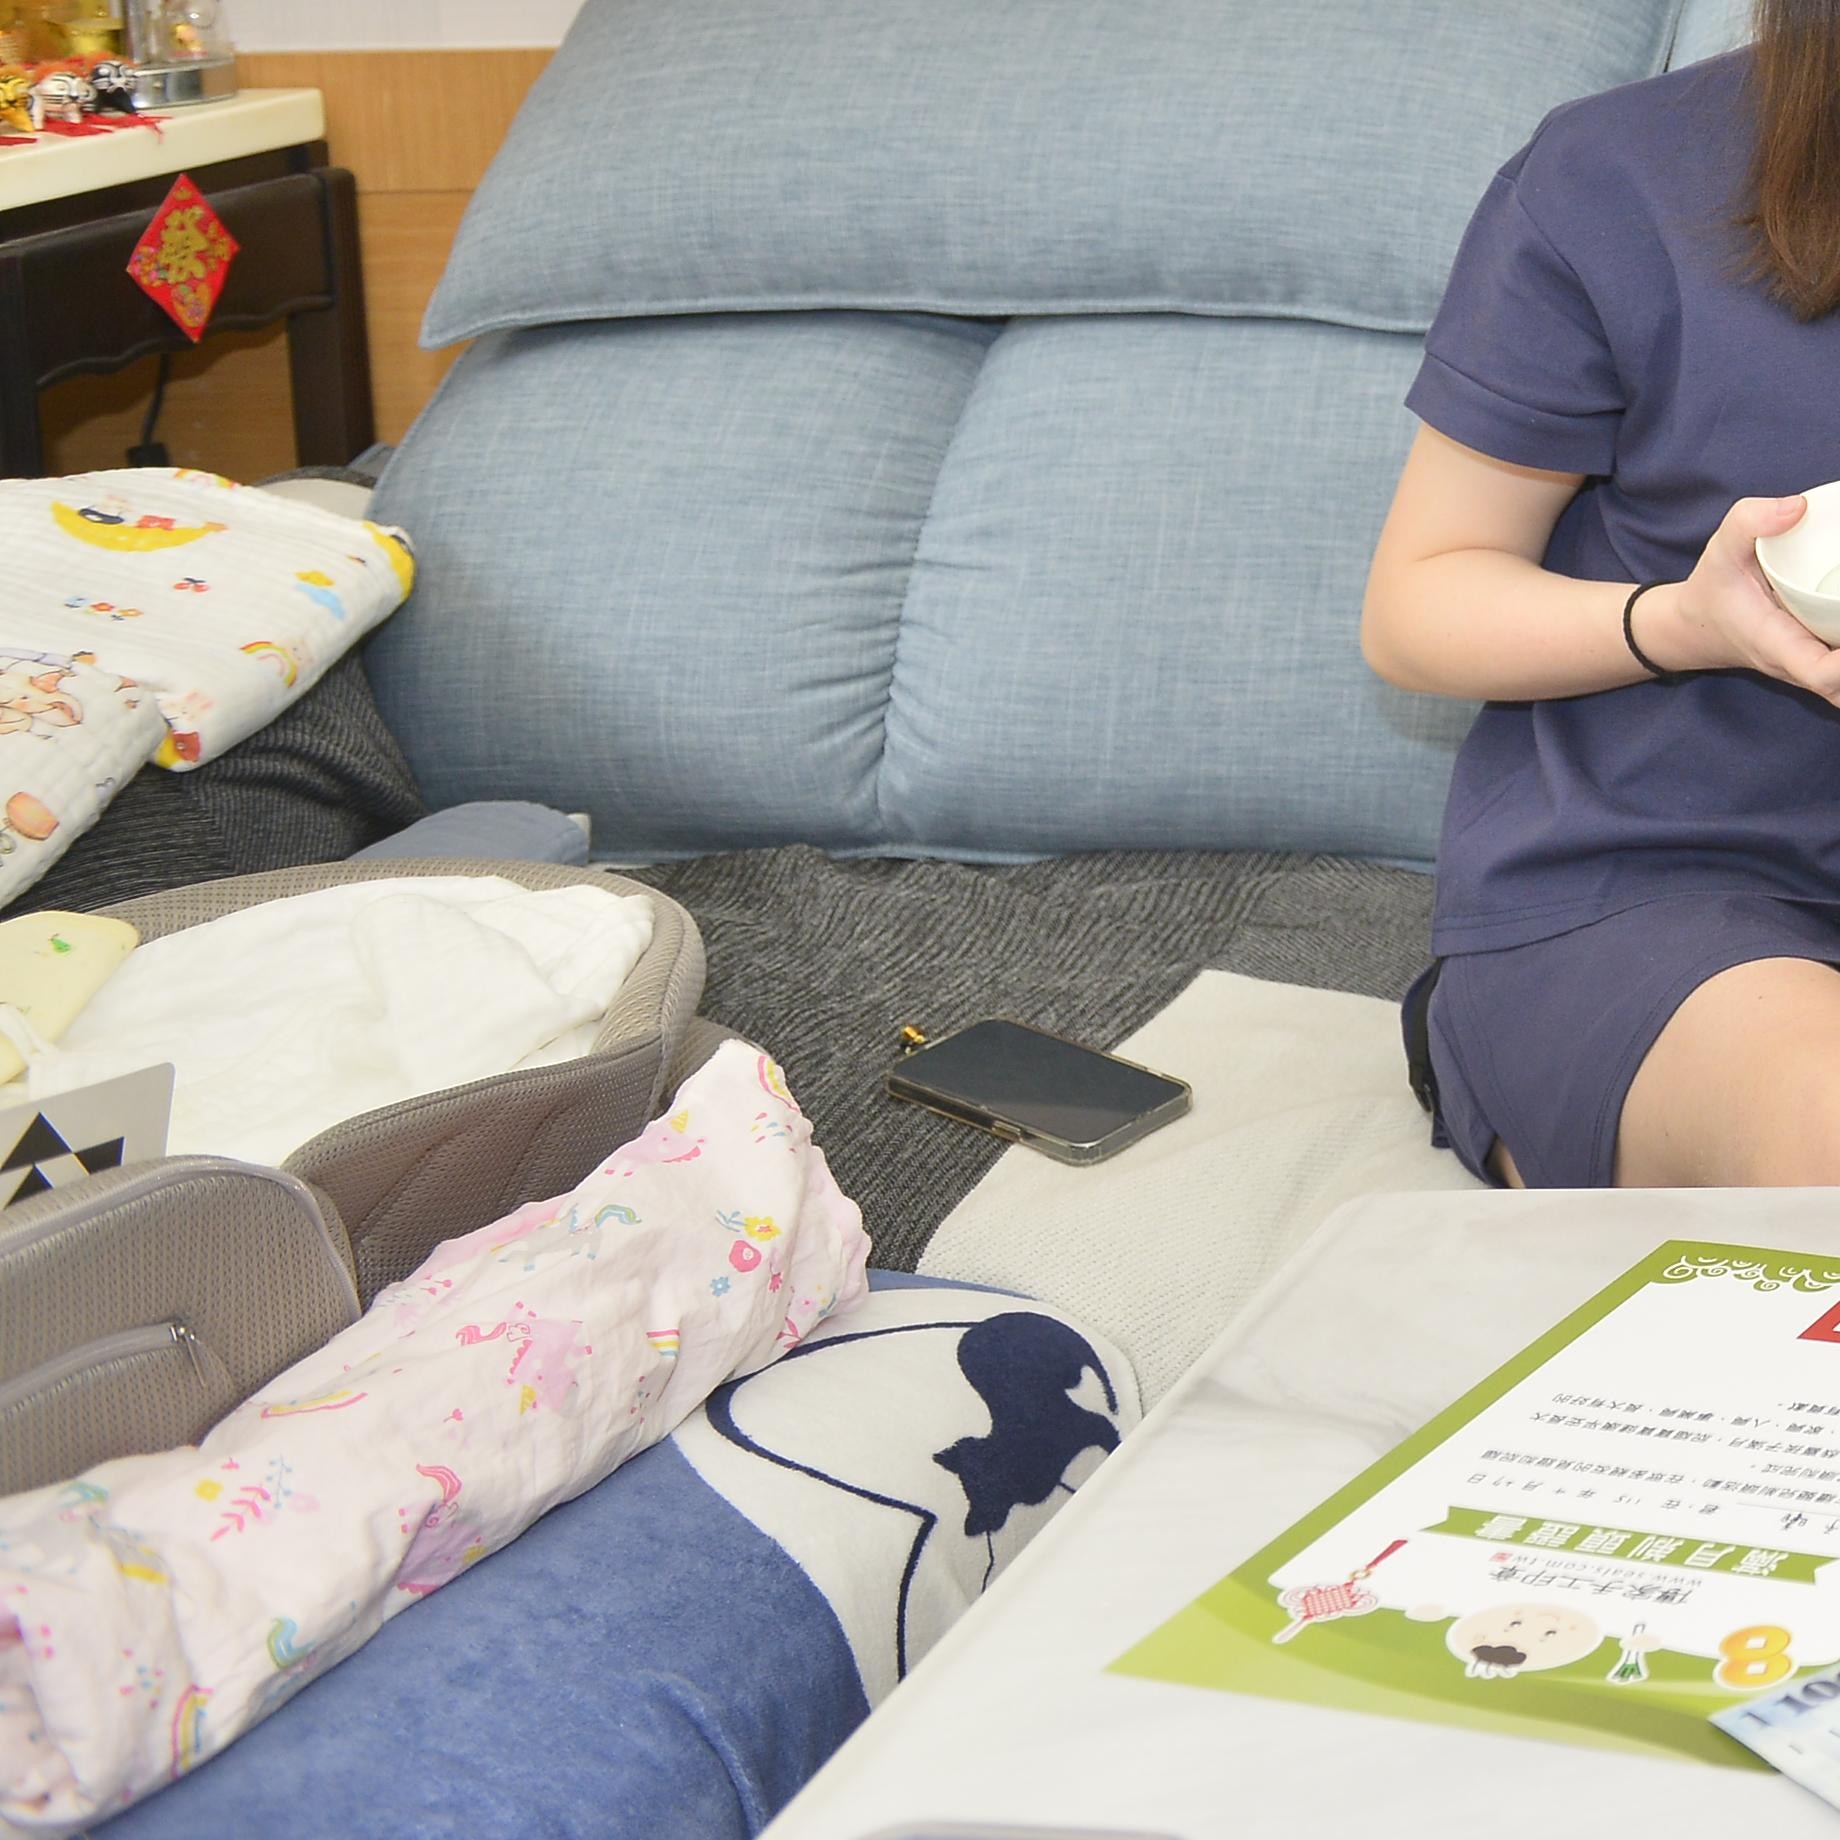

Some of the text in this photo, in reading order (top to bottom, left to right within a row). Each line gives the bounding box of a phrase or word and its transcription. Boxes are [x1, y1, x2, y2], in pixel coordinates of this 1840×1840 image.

[1467, 1473, 1487, 1484] 日
[1521, 1481, 1544, 1491] 月
[1474, 1513, 1788, 1576] 滿月剃頭證書
[1490, 1566, 1692, 1604] 傳家手工印章
[1512, 1555, 1702, 1591] www.seals.com.tw
